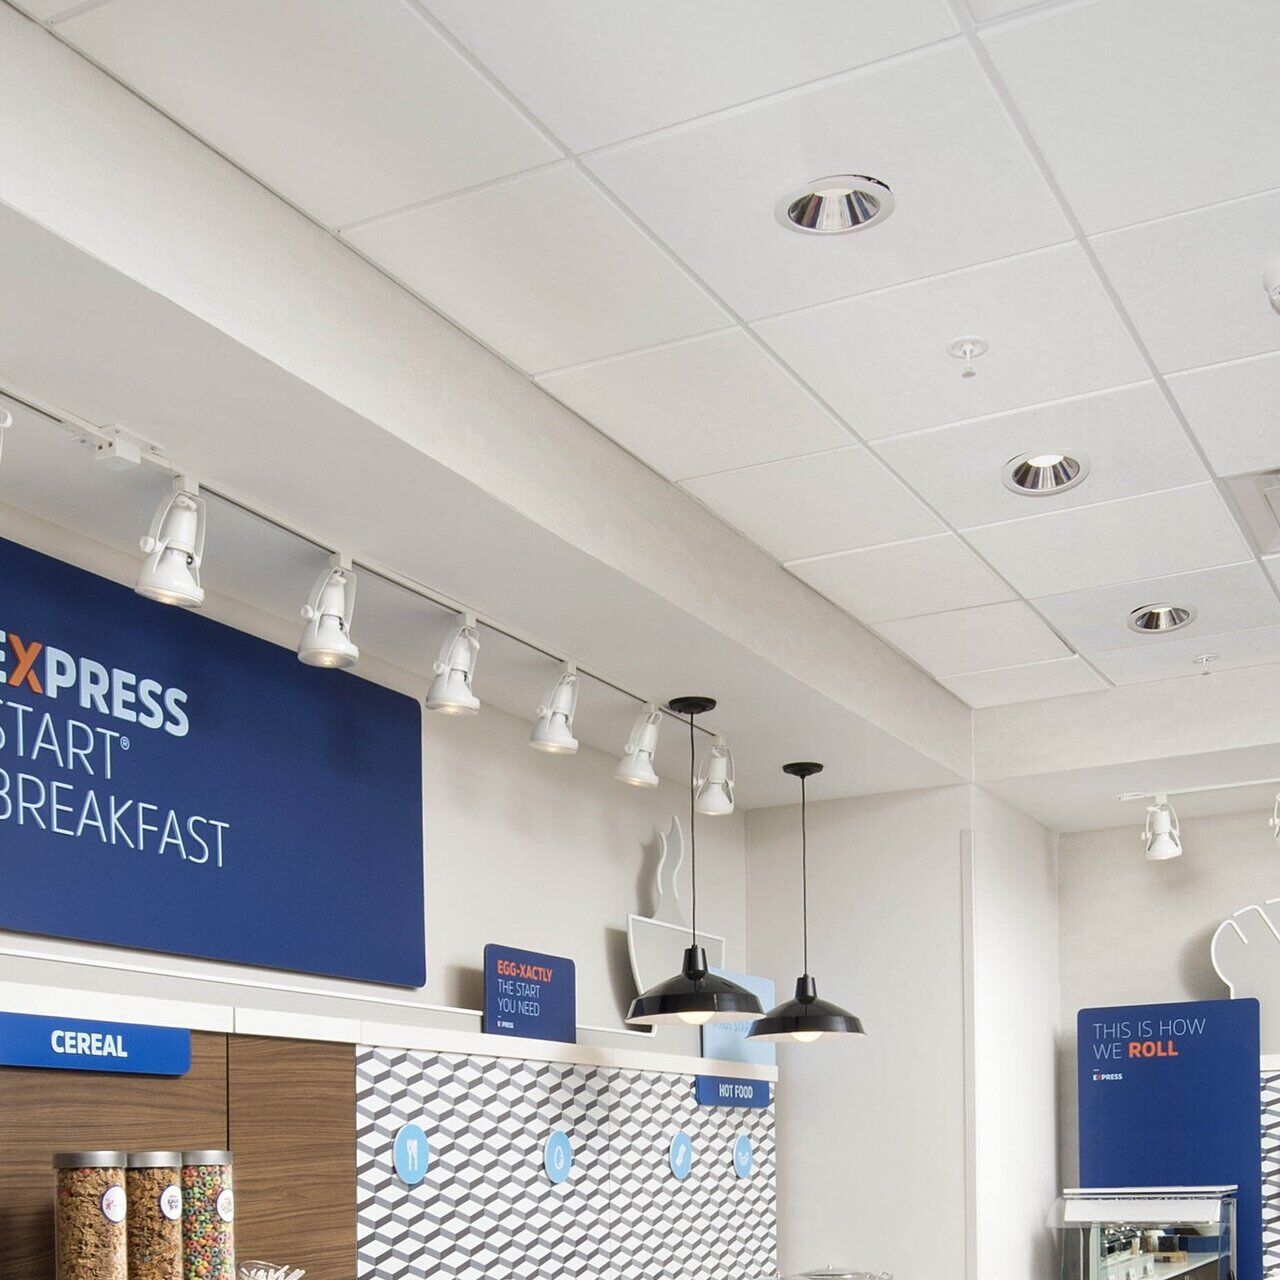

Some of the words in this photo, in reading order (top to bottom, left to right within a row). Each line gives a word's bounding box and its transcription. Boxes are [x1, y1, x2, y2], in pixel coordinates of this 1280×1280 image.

[497, 959, 553, 983] EGG-XACTLY
[497, 978, 514, 995] THE
[515, 982, 541, 999] START
[497, 997, 516, 1013] YOU
[518, 1000, 541, 1017] NEED
[1092, 1021, 1132, 1039] THIS
[1137, 1020, 1153, 1038] IS
[1159, 1017, 1207, 1036] HOW
[50, 1029, 129, 1058] CEREAL
[1092, 1042, 1123, 1060] WE
[1128, 1039, 1179, 1059] ROLL
[719, 1083, 734, 1098] HOT
[734, 1085, 754, 1099] FOOD
